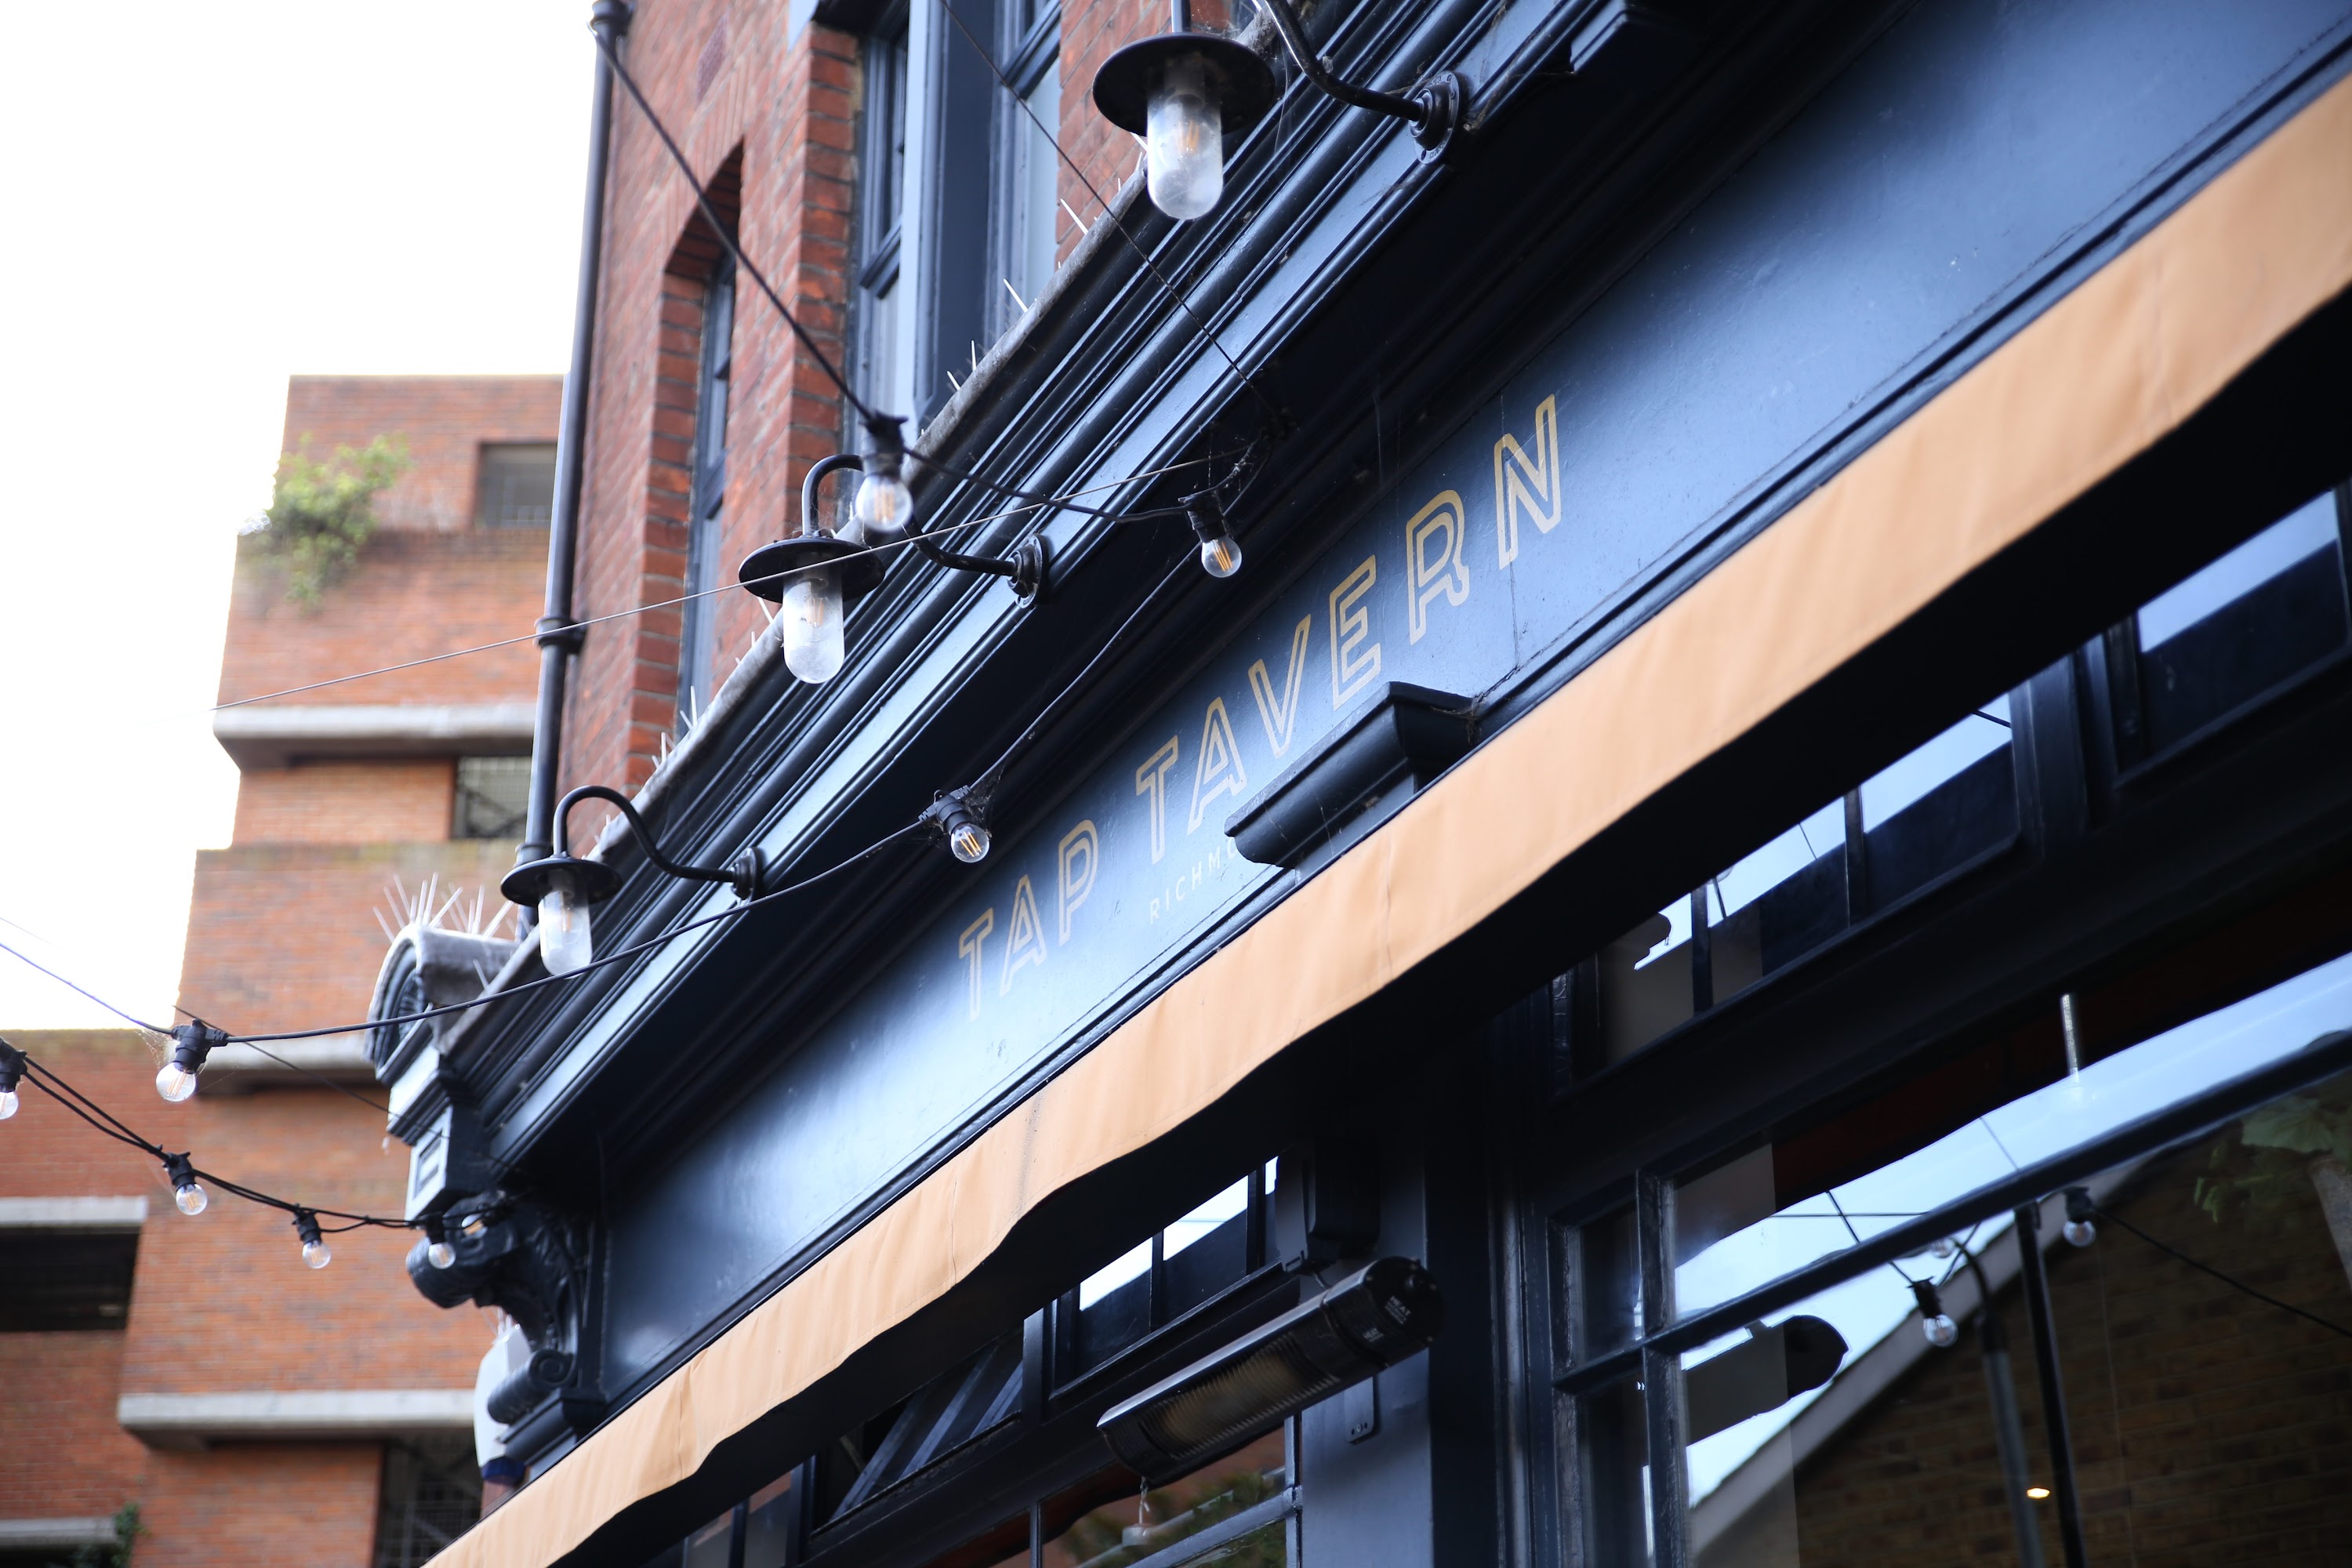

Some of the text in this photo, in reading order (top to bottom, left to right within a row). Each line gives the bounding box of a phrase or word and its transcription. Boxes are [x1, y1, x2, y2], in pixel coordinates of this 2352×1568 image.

[958, 393, 1563, 1022] TAP TAVERN
[1390, 1295, 1411, 1316] HEAT
